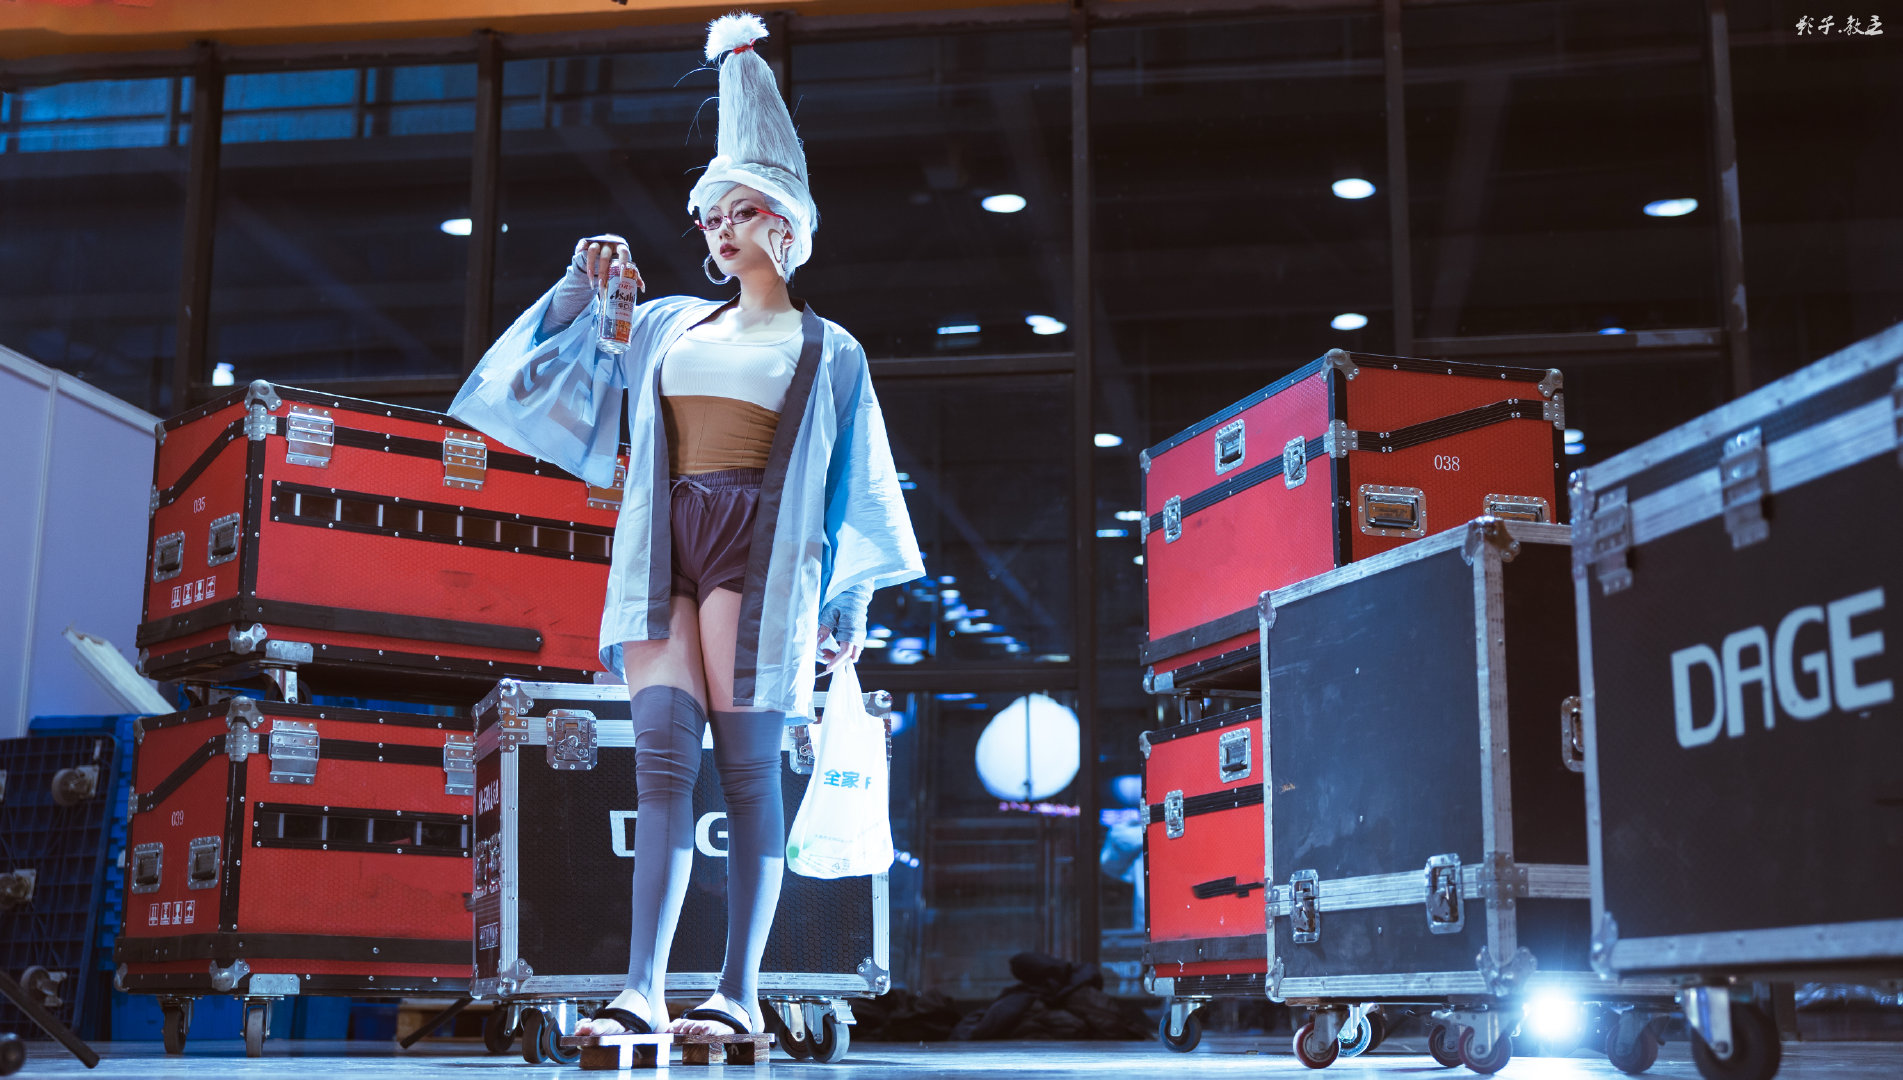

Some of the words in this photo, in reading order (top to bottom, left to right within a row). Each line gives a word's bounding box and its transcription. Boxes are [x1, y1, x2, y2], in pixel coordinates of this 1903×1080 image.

[609, 289, 636, 303] Asahi
[1434, 454, 1460, 471] 038
[193, 496, 206, 514] 035
[1671, 586, 1894, 748] DAGE
[823, 769, 860, 788] 全家
[171, 810, 184, 827] 039
[609, 810, 729, 857] DG
